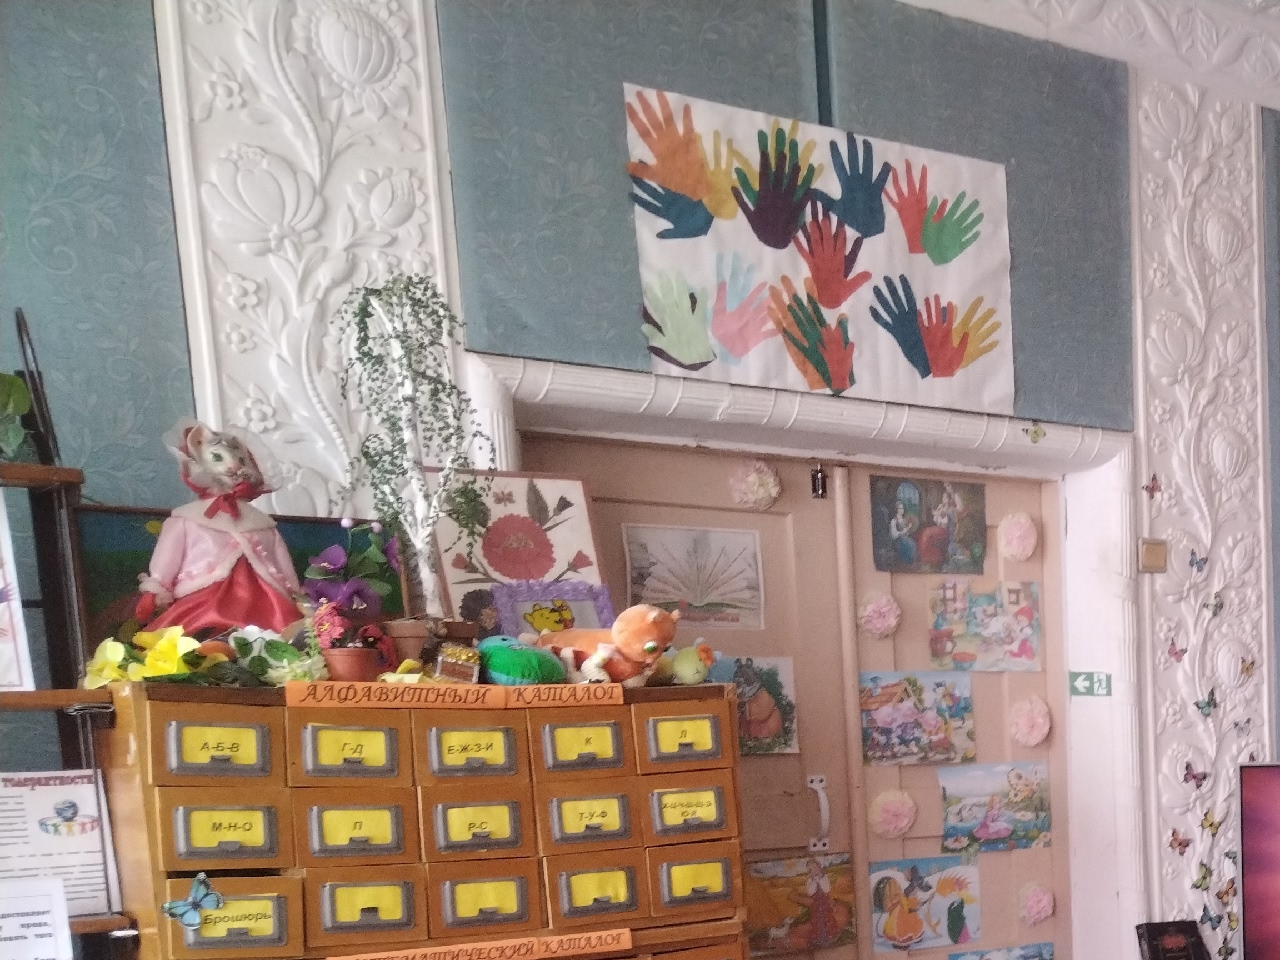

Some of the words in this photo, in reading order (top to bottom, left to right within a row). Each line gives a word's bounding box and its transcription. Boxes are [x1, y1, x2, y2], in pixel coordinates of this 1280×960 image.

[300, 684, 492, 706] АЛФАВИТНЫЙ
[512, 684, 620, 704] КАТАЛОГ
[199, 741, 240, 753] А-Б-В
[584, 736, 594, 747] К
[341, 743, 365, 755] Г-Д
[447, 743, 495, 755] Е-Ж-З-И
[578, 809, 609, 822] Т-У-Ф
[211, 820, 253, 833] М-Н-О
[353, 820, 363, 832] П
[467, 820, 489, 832] Р-С
[541, 931, 626, 954] КАТАЛОГ
